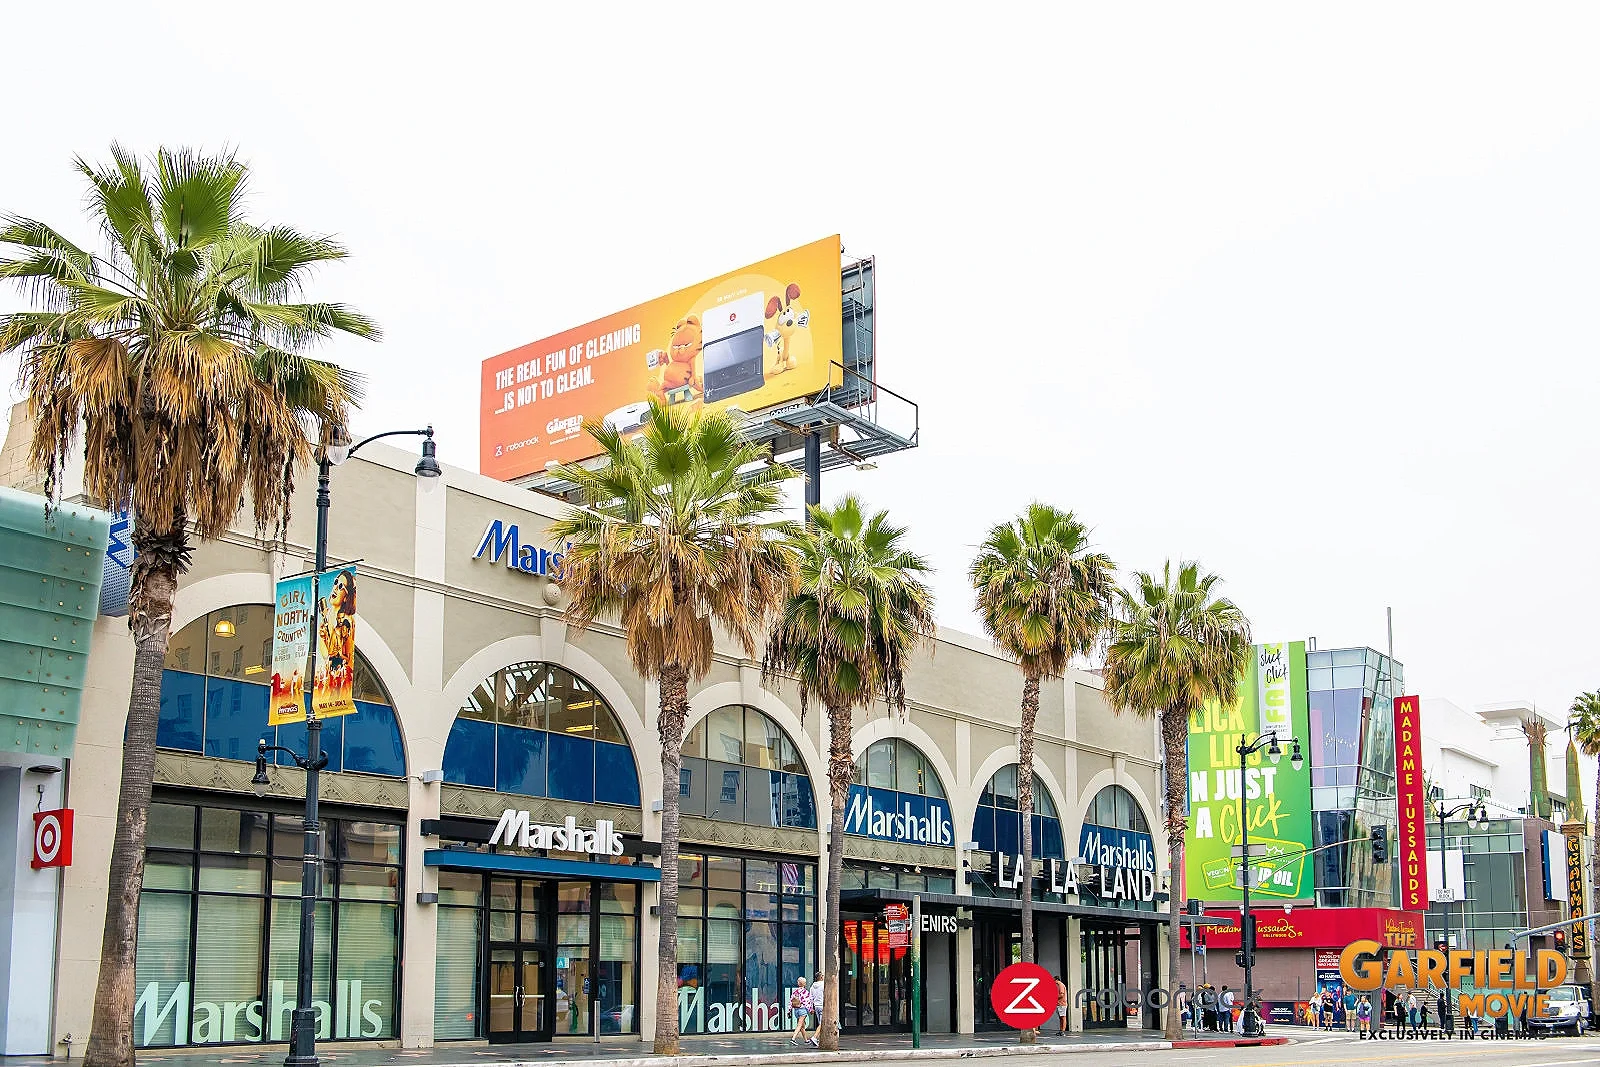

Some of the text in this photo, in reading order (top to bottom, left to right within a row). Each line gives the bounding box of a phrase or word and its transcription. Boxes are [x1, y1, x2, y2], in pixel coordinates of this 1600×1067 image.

[496, 323, 641, 391] THE REAL FUN OF CLEANING
[517, 384, 538, 407] NOT
[540, 378, 554, 400] TO
[556, 365, 595, 394] CLEAN.
[506, 436, 539, 452] roborock
[276, 609, 309, 627] NORTH
[281, 590, 306, 607] GIRL
[277, 626, 307, 642] COUNTRY
[1210, 732, 1262, 768] LIPS
[1214, 767, 1277, 801] JUST
[1400, 701, 1419, 905] MADAME TUSSAUDS
[488, 809, 624, 856] Marshalls
[843, 793, 951, 845] Marshalls
[1196, 792, 1291, 843] A Click
[1082, 831, 1154, 872] Marshalls
[998, 851, 1155, 902] LA LA LAND
[1273, 870, 1294, 887] OIL
[1206, 918, 1297, 938] Madam ussauds
[133, 979, 383, 1046] Marshalls
[678, 986, 810, 1033] Marshal
